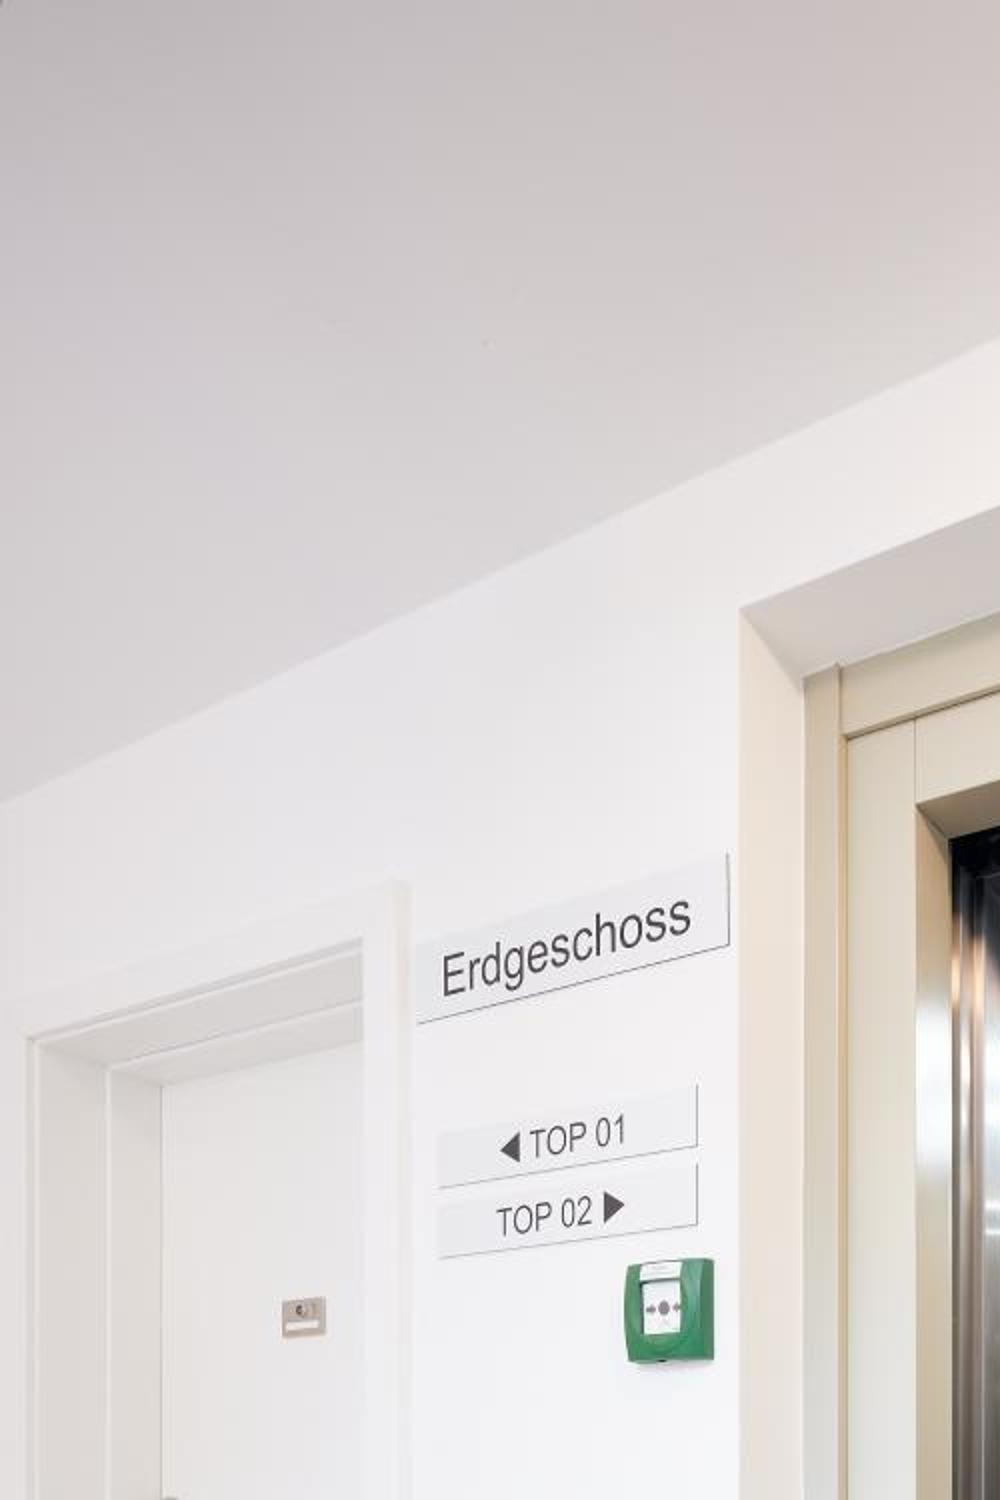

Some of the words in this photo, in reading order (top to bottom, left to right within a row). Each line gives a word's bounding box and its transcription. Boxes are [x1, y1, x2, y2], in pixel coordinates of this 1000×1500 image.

[443, 900, 692, 997] Erdgeschoss
[529, 1121, 587, 1158] TOP
[595, 1113, 625, 1148] 01
[496, 1201, 553, 1236] TOP
[561, 1195, 592, 1229] 02
